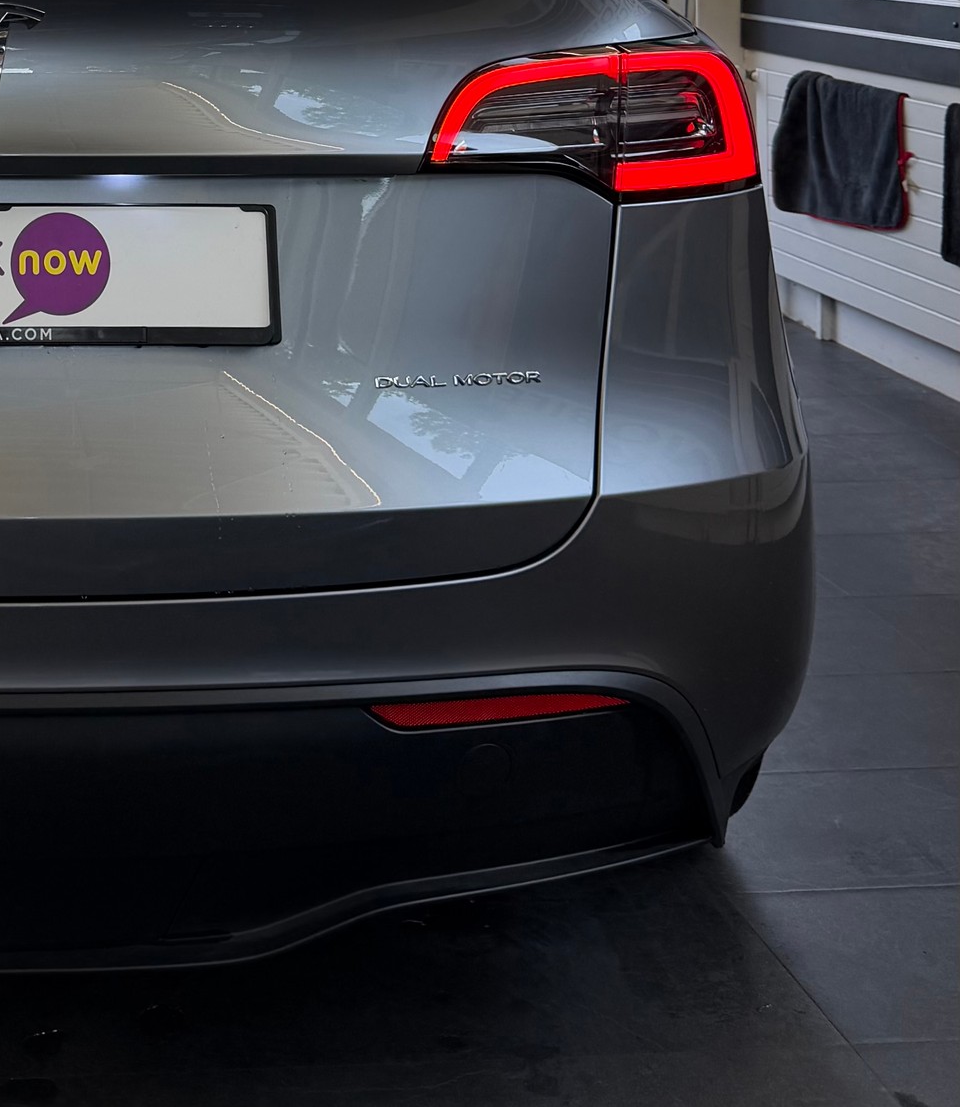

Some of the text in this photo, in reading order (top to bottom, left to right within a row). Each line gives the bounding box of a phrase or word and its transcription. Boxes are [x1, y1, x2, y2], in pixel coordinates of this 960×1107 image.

[18, 249, 102, 275] now
[374, 370, 541, 389] DUAL MOTOR
